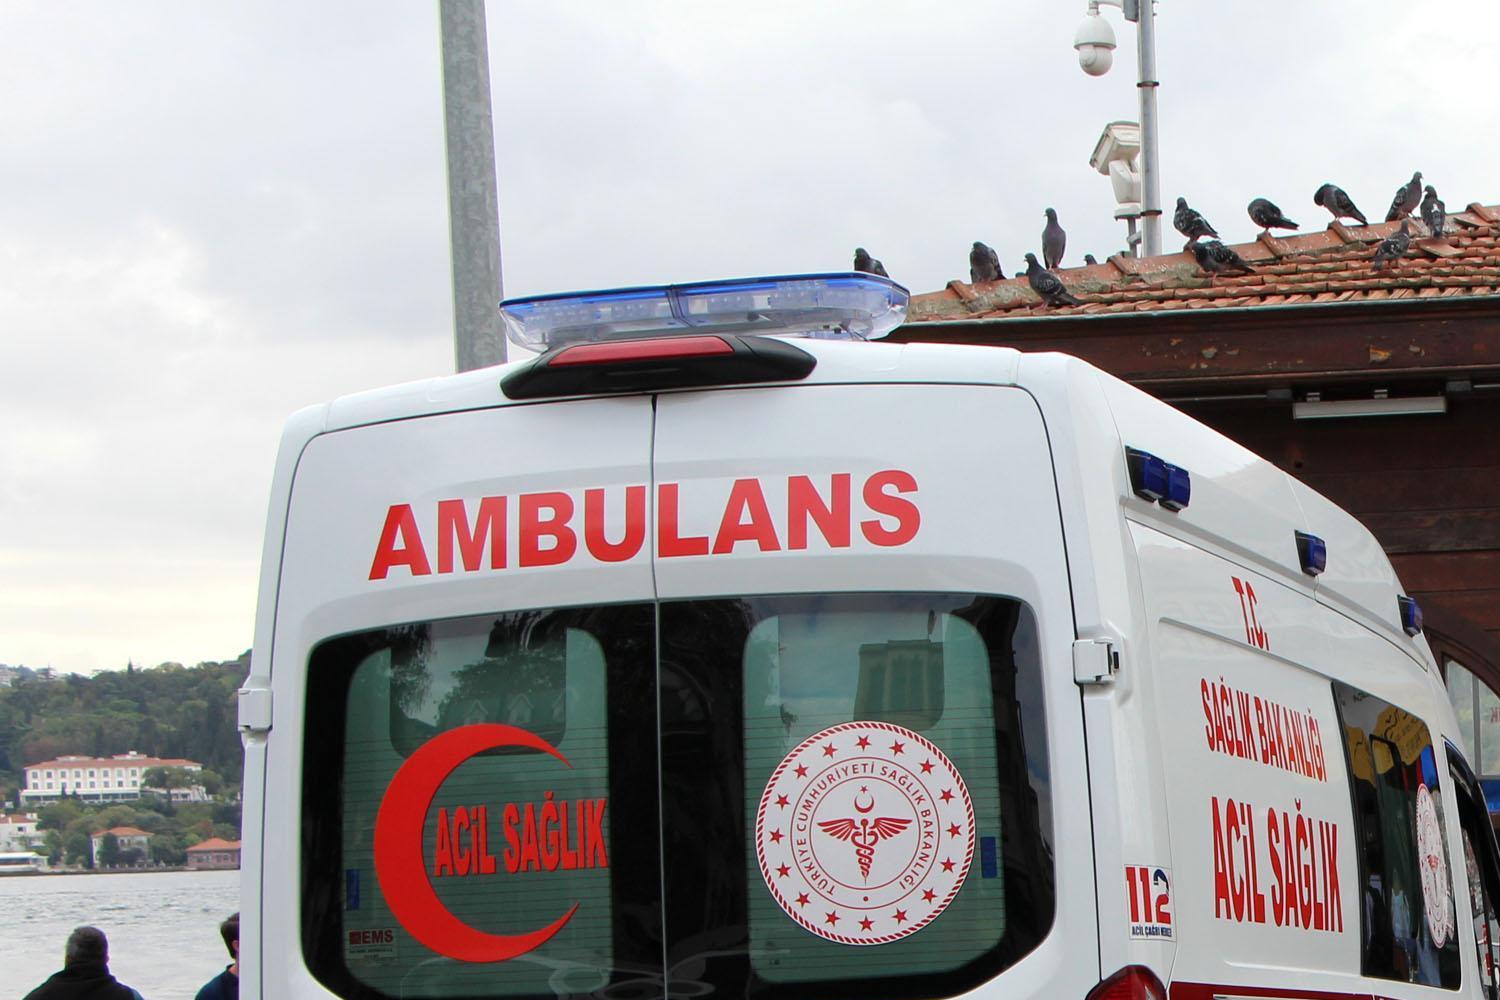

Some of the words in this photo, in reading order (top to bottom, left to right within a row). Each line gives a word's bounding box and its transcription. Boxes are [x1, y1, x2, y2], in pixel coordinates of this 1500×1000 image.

[367, 469, 921, 581] AMBULANS
[1231, 576, 1270, 651] T.C.
[1201, 675, 1258, 762] SAĞLIK
[1254, 696, 1327, 783] BAKANLIĞI
[797, 761, 876, 832] CUMHURİYETİ
[880, 765, 926, 806] SAĞLIK
[503, 790, 608, 874] SAĞLIK
[797, 838, 836, 897] TÜRKİYE
[899, 809, 934, 890] BAKANLIĞI
[1267, 797, 1344, 933] SAĞLIK
[1126, 867, 1171, 925] 112
[361, 929, 394, 944] EMS
